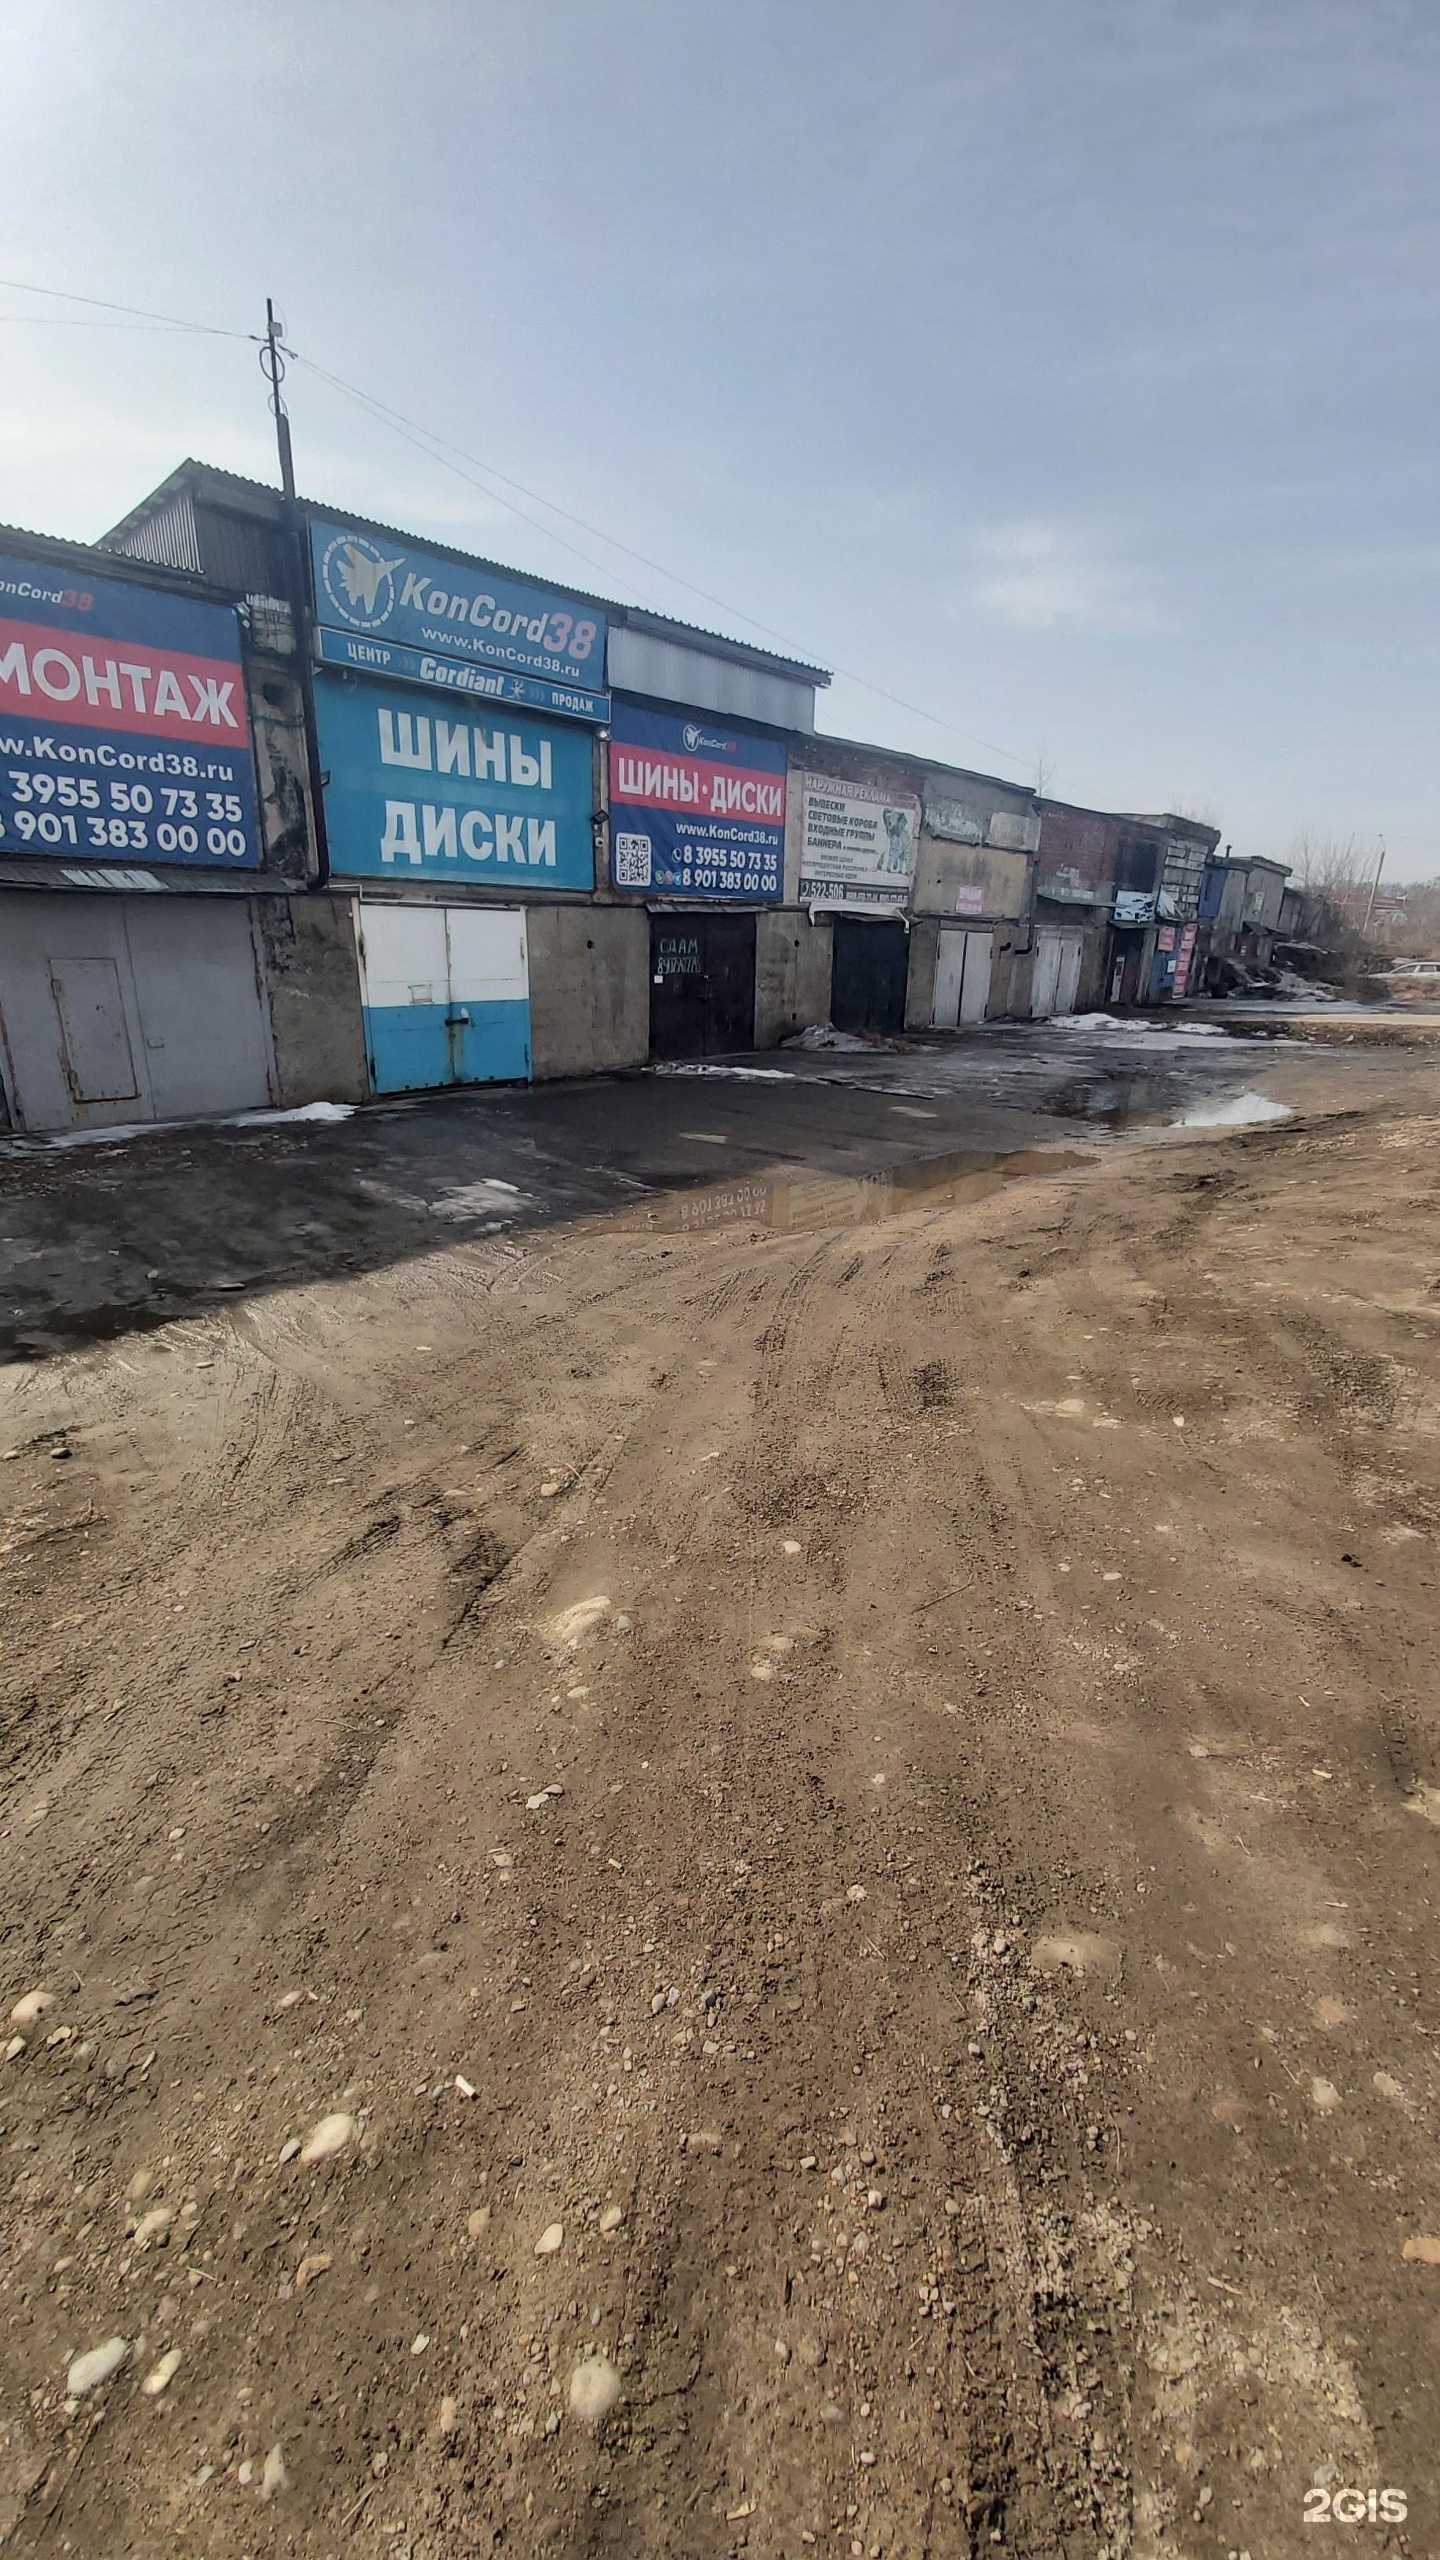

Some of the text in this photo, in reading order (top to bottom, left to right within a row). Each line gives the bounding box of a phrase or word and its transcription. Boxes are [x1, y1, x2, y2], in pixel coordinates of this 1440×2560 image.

[399, 572, 597, 660] KonCord38
[347, 642, 392, 666] ЦЕНТР
[421, 624, 580, 678] www.KonCord38.ru
[0, 642, 240, 728] МОНТАЖ
[419, 656, 505, 697] Cordiant
[551, 691, 594, 713] ПРОДАЖ
[378, 708, 553, 790] ШИНЫ
[8, 770, 243, 823] 3955 50 73 35
[618, 757, 782, 817] ШИНЫ ДИСКИ
[808, 796, 846, 812] ВЫВЕСКИ
[807, 810, 848, 826] СВЕТОВЫЕ
[14, 810, 78, 846] 901
[86, 816, 149, 850] 383
[156, 822, 199, 854] 00
[207, 828, 247, 857] 00
[380, 799, 557, 867] ДИСКИ
[675, 821, 779, 846] www.KonCord38.ru
[807, 823, 876, 842] ВХОДНЫЕ ГРУППЫ
[807, 836, 842, 850] БАННЕРА
[684, 845, 692, 864] 8
[695, 845, 727, 868] 3955
[729, 848, 746, 869] 50
[748, 850, 762, 870] 73
[762, 851, 778, 872] 35
[683, 869, 778, 892] 8 901 383 00 00
[811, 881, 844, 900] 522-506
